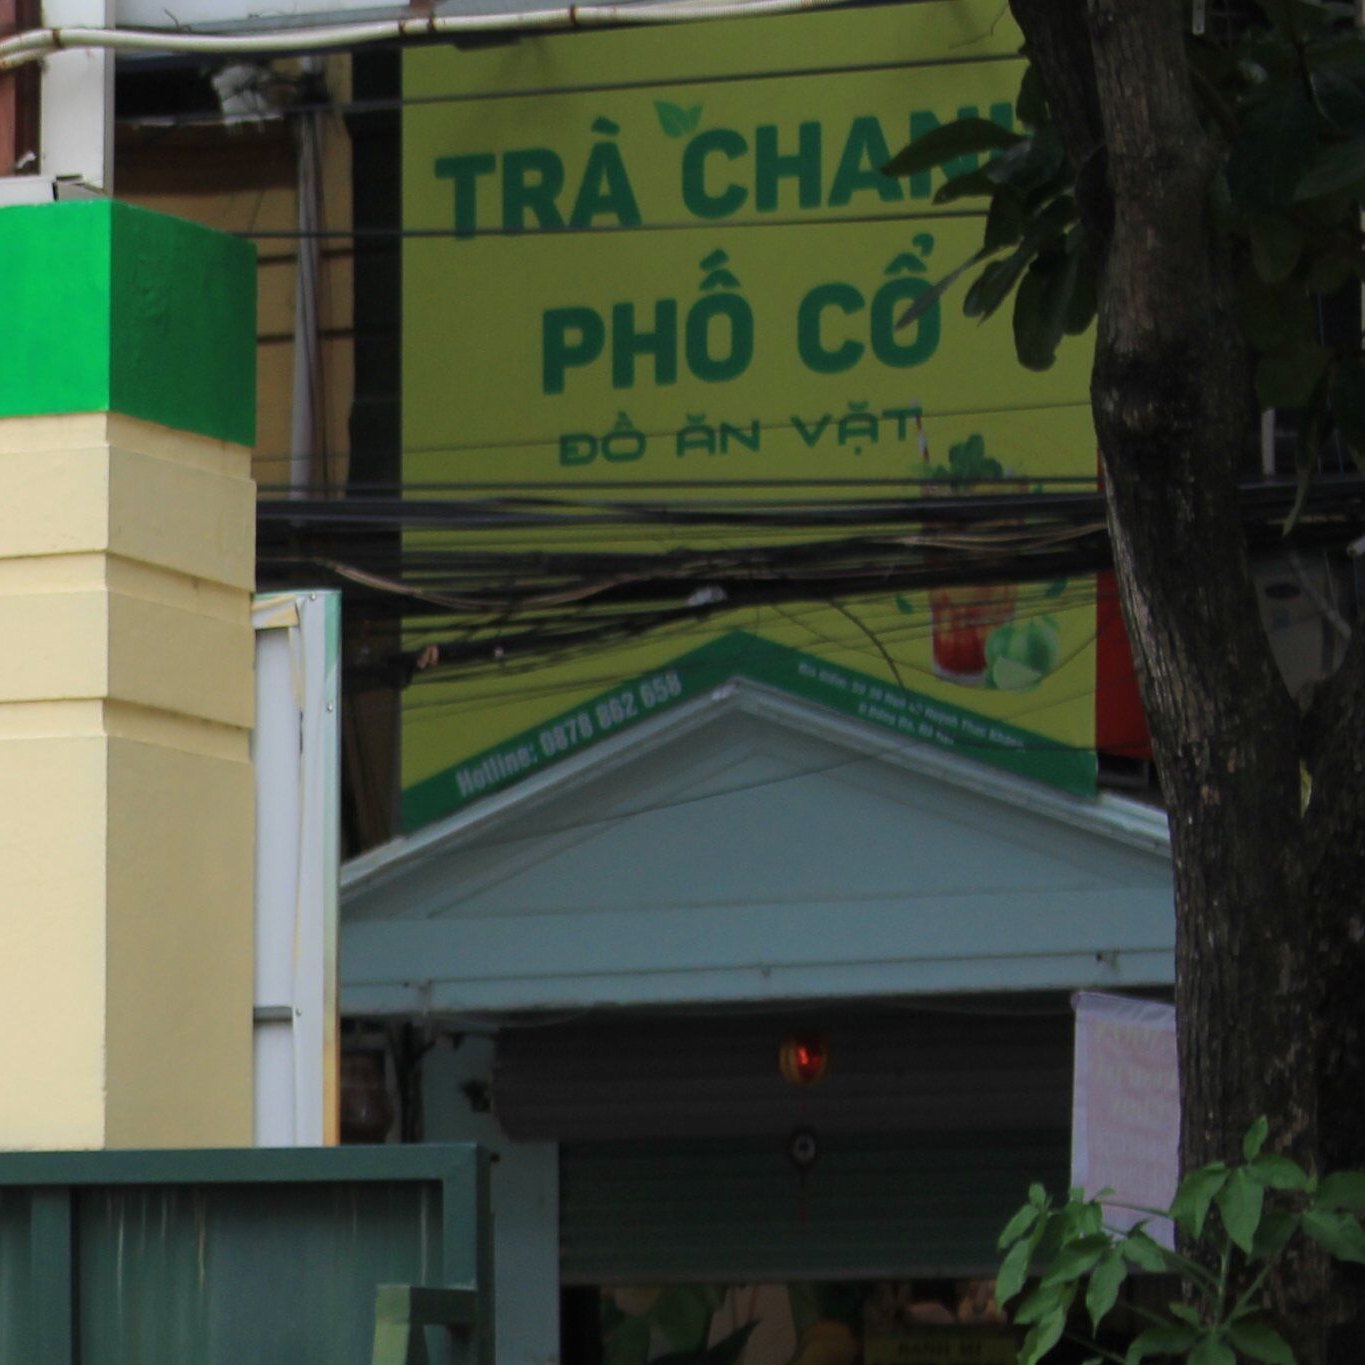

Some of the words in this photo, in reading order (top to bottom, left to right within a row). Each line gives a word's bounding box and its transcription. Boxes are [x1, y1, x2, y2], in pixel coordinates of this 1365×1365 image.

[434, 115, 642, 240] TRÀ
[681, 102, 1013, 220] CHAN
[542, 248, 754, 395] PHỐ
[797, 233, 942, 374] CỔ
[559, 410, 647, 467] ĐỒ
[676, 412, 761, 458] ĂN
[790, 400, 923, 456] VẶT
